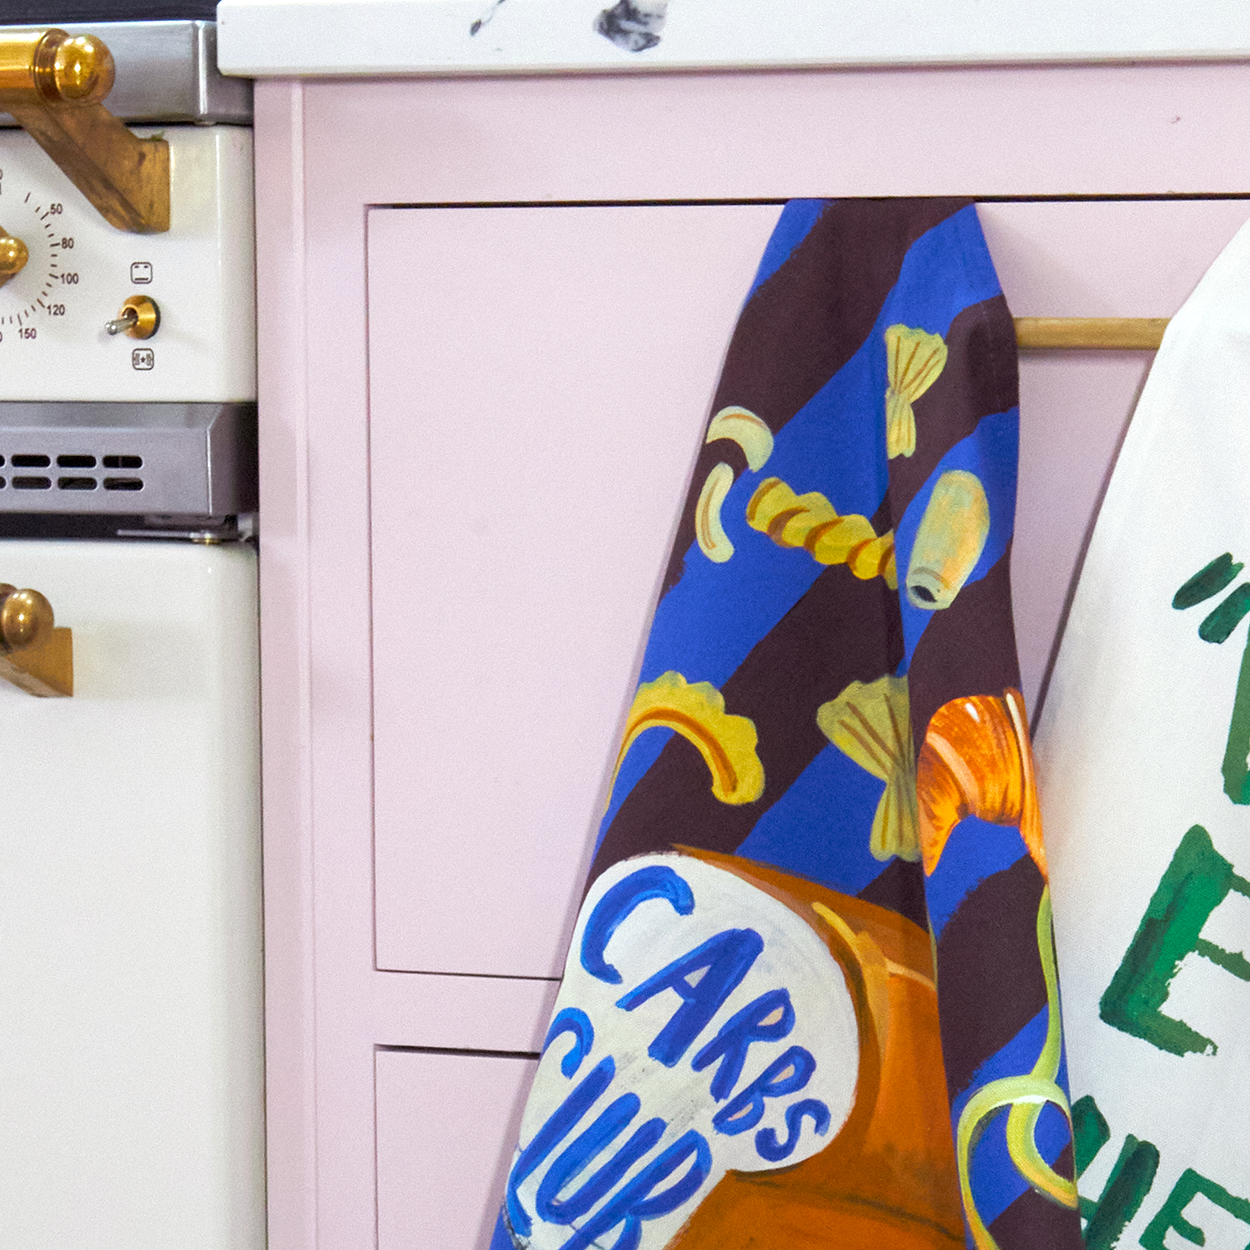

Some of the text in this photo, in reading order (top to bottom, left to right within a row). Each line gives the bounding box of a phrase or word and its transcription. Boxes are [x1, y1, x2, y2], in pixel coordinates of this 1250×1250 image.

[50, 203, 63, 215] 50
[61, 237, 74, 249] 80
[60, 273, 79, 285] 100
[47, 304, 65, 316] 120
[18, 328, 37, 340] 150
[580, 864, 832, 1163] CARBS
